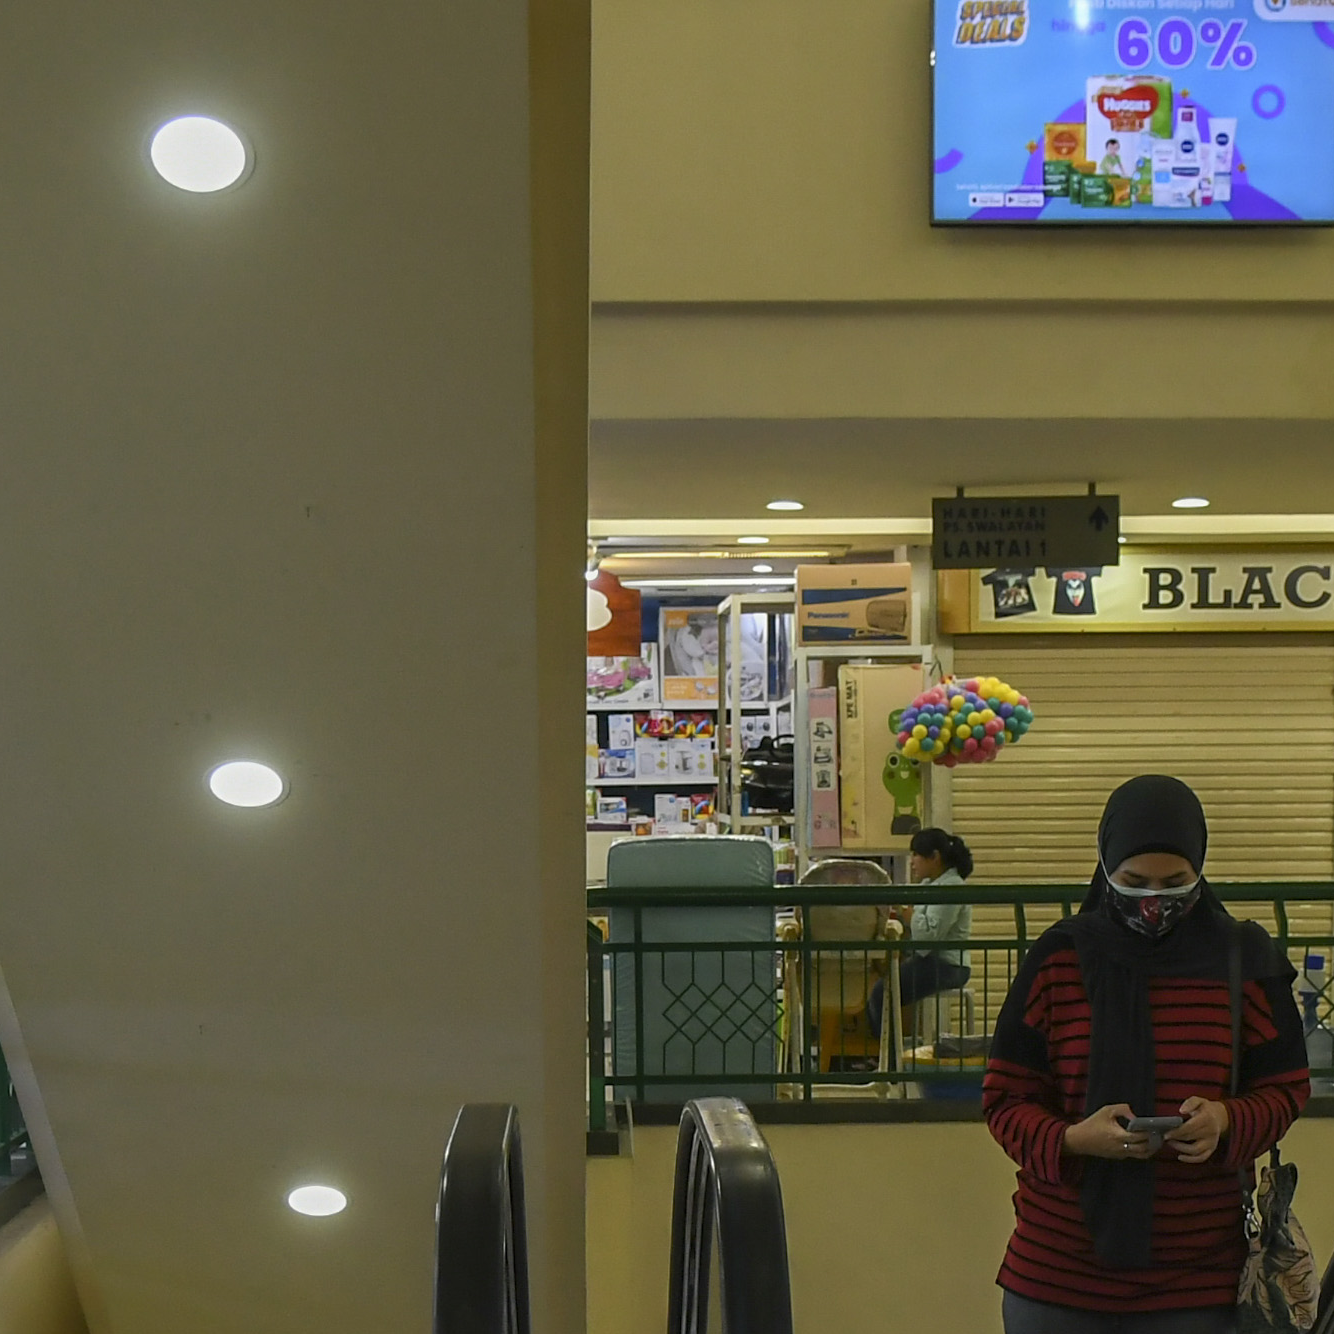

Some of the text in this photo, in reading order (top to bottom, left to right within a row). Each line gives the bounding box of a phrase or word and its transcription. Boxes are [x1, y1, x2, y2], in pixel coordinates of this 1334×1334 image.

[955, 16, 1026, 45] DEALS
[1117, 18, 1254, 68] 60%
[943, 538, 1047, 559] LANTAI 1
[807, 611, 850, 619] Panasonic
